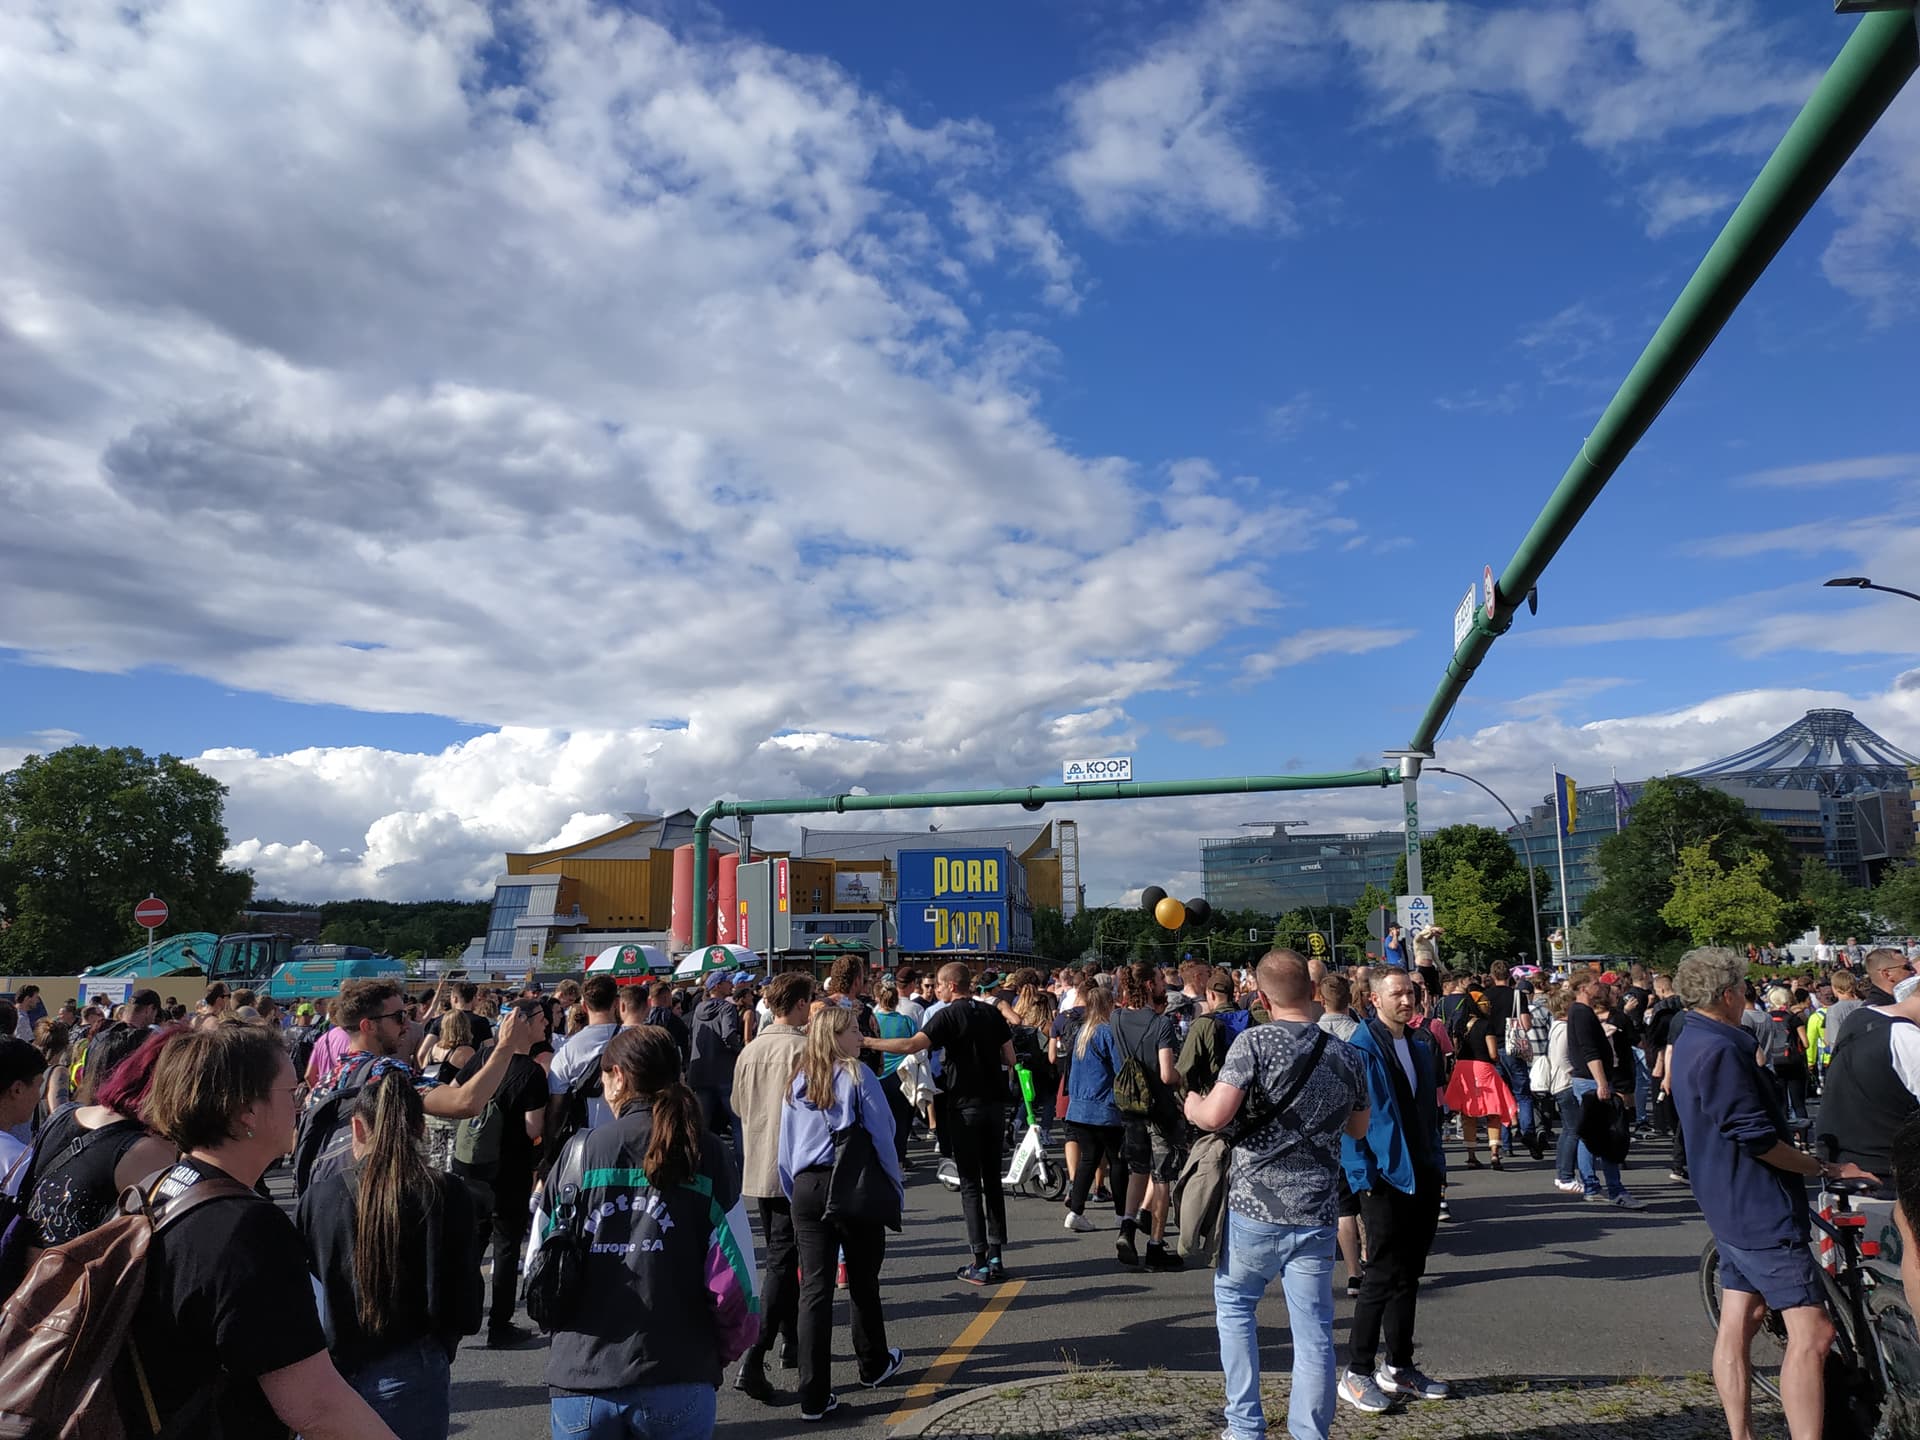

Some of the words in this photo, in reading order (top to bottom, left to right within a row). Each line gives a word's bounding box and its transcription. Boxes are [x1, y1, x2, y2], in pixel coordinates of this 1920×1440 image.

[1086, 760, 1129, 774] KOOP
[1405, 801, 1419, 856] KOOP
[934, 856, 999, 897] PORR
[170, 1165, 200, 1186] SARAH
[159, 1178, 189, 1199] CONNO
[590, 1242, 636, 1257] urope
[641, 1239, 664, 1252] SA
